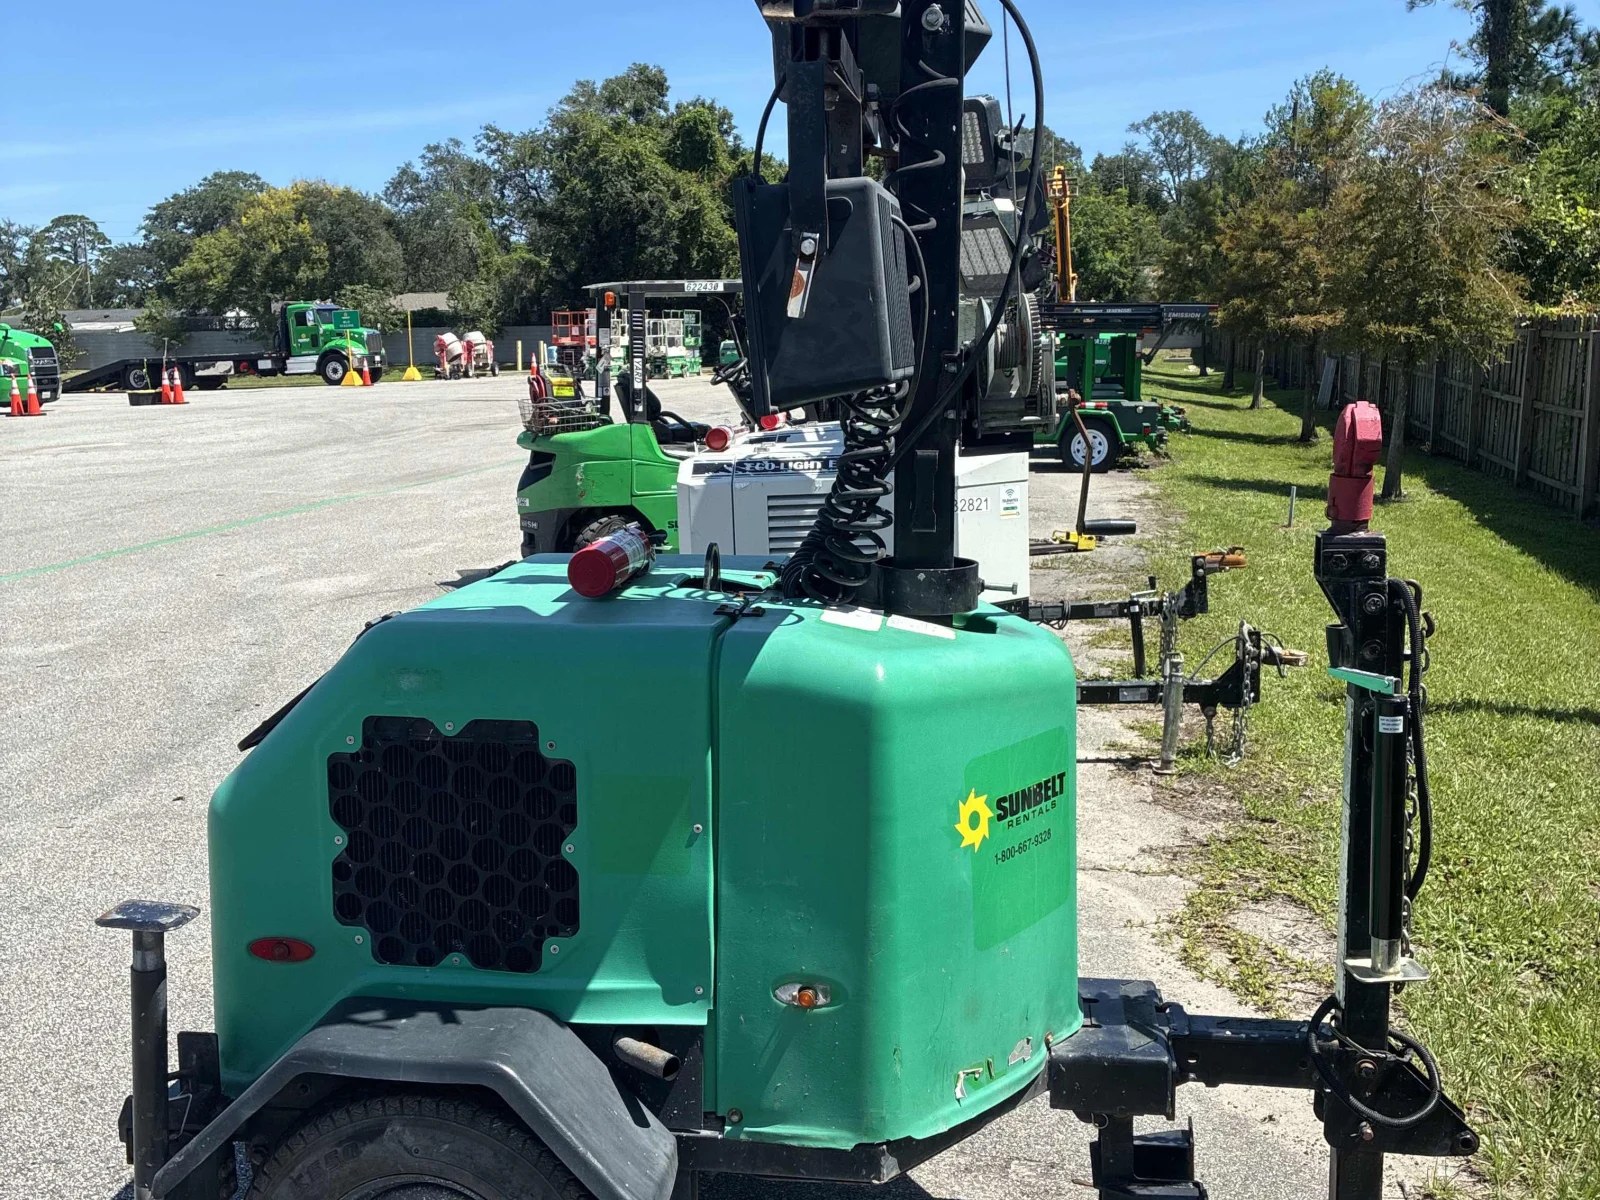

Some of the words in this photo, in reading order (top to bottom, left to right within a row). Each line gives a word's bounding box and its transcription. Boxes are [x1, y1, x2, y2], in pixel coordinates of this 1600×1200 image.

[686, 282, 719, 291] 622430
[634, 360, 642, 384] YARD
[996, 771, 1066, 822] SUNBELT
[1007, 800, 1057, 830] RENTALS
[994, 828, 1052, 865] 1-800-667-9328
